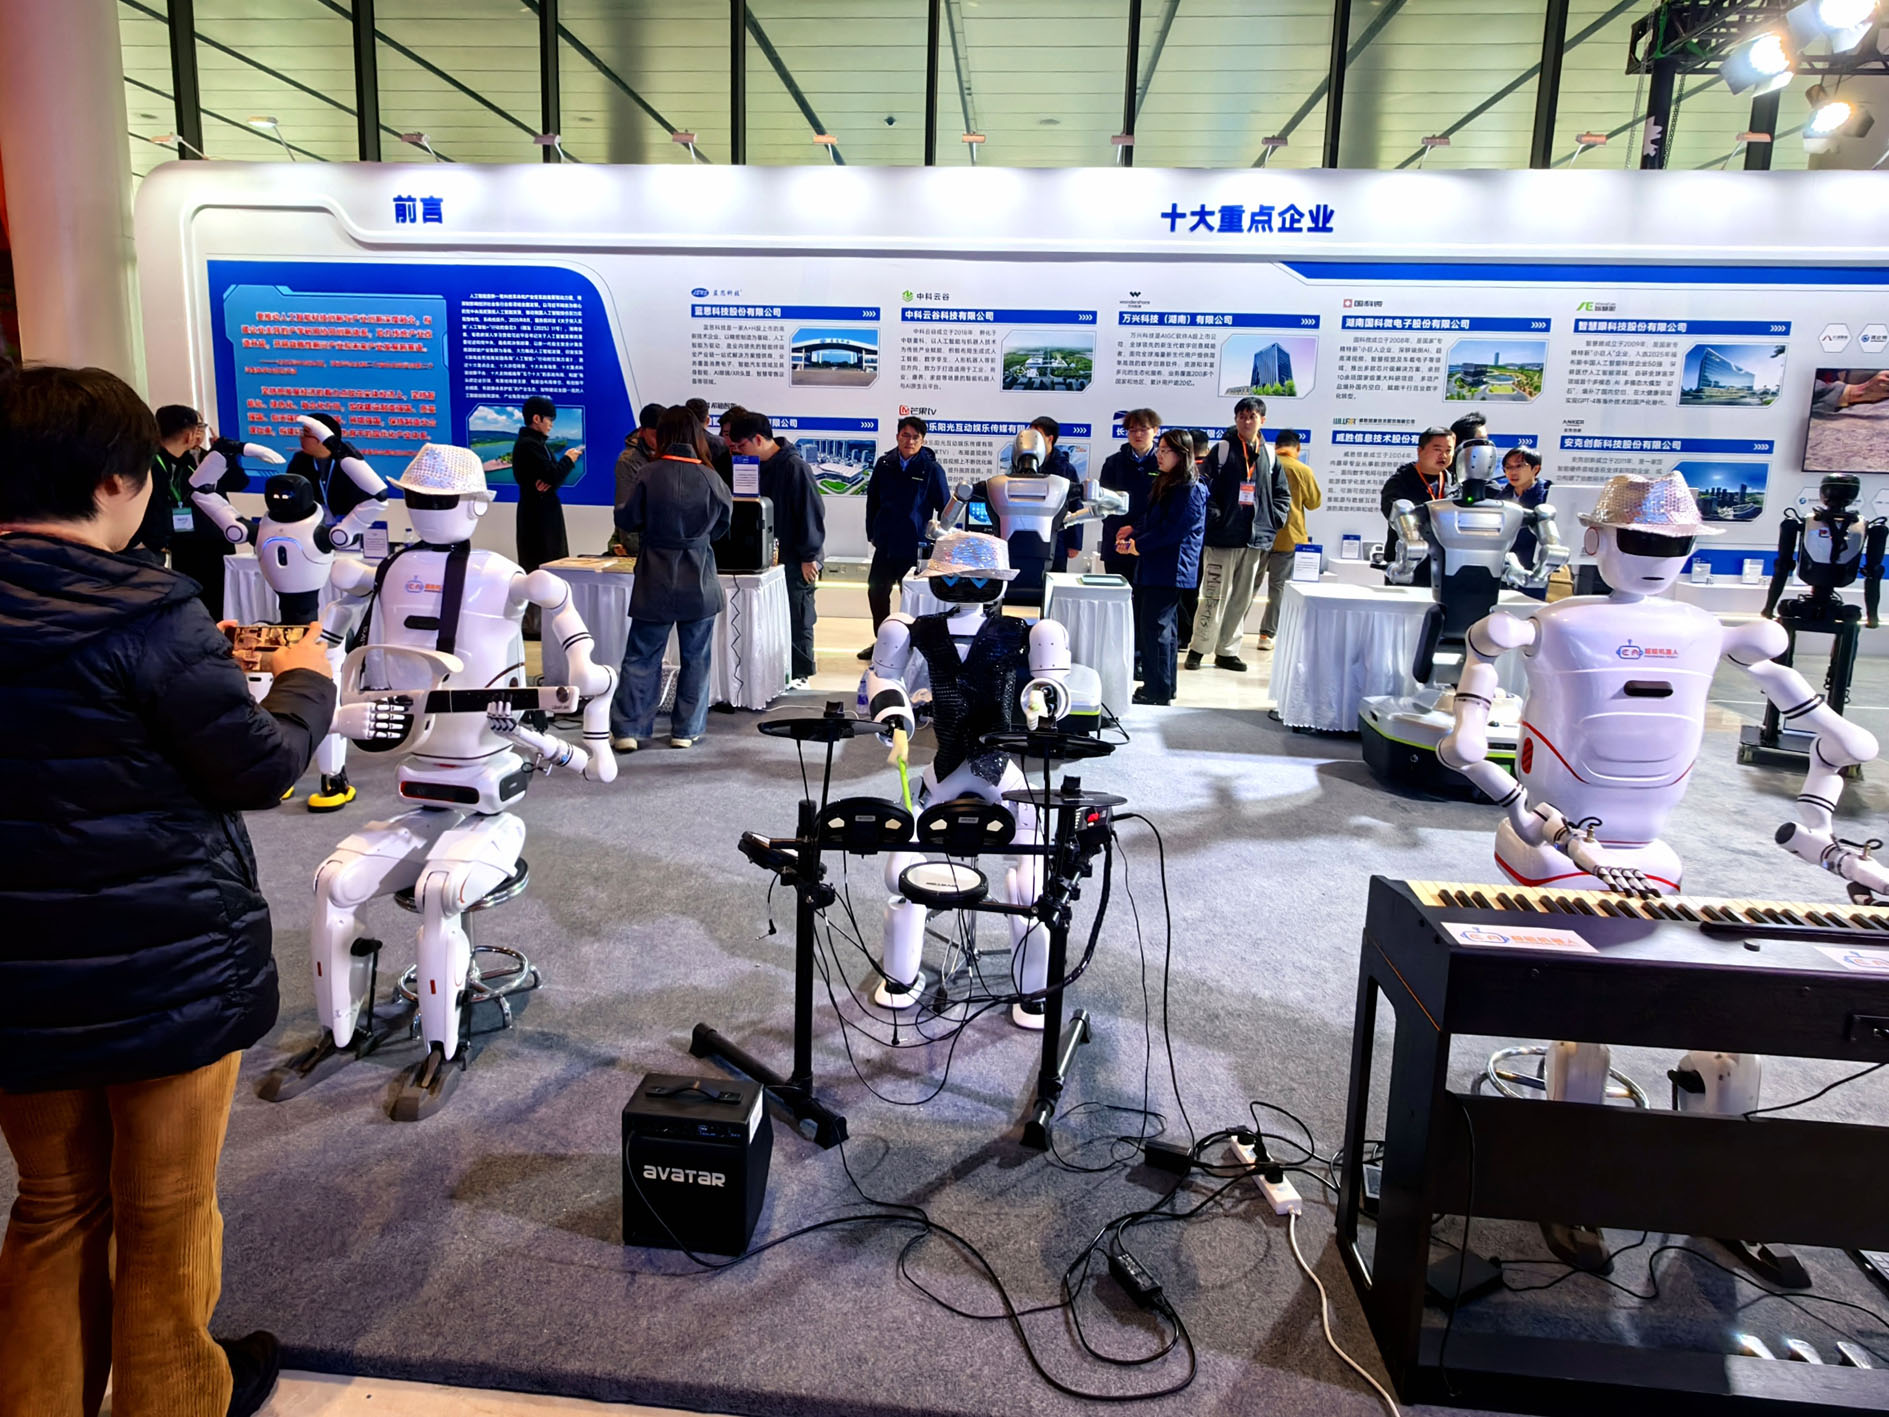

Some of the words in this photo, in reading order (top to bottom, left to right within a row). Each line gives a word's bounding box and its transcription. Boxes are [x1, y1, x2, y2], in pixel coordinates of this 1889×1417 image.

[393, 195, 443, 224] 前言
[1161, 203, 1335, 233] 十大重点企业
[916, 293, 950, 301] 中科云谷
[694, 306, 781, 318] 蓝思科技股份有限公司
[905, 310, 994, 321] 中科云谷科技有限公司
[1122, 314, 1232, 325] 万兴科技（湖南）有限公司
[1345, 318, 1470, 330] 湖南国科微电子股份有限公司
[1578, 321, 1687, 332] 智慧眼科技股份有限公司
[769, 418, 798, 428] 限公司
[1564, 438, 1682, 450] 安克创新科技股份有限公司
